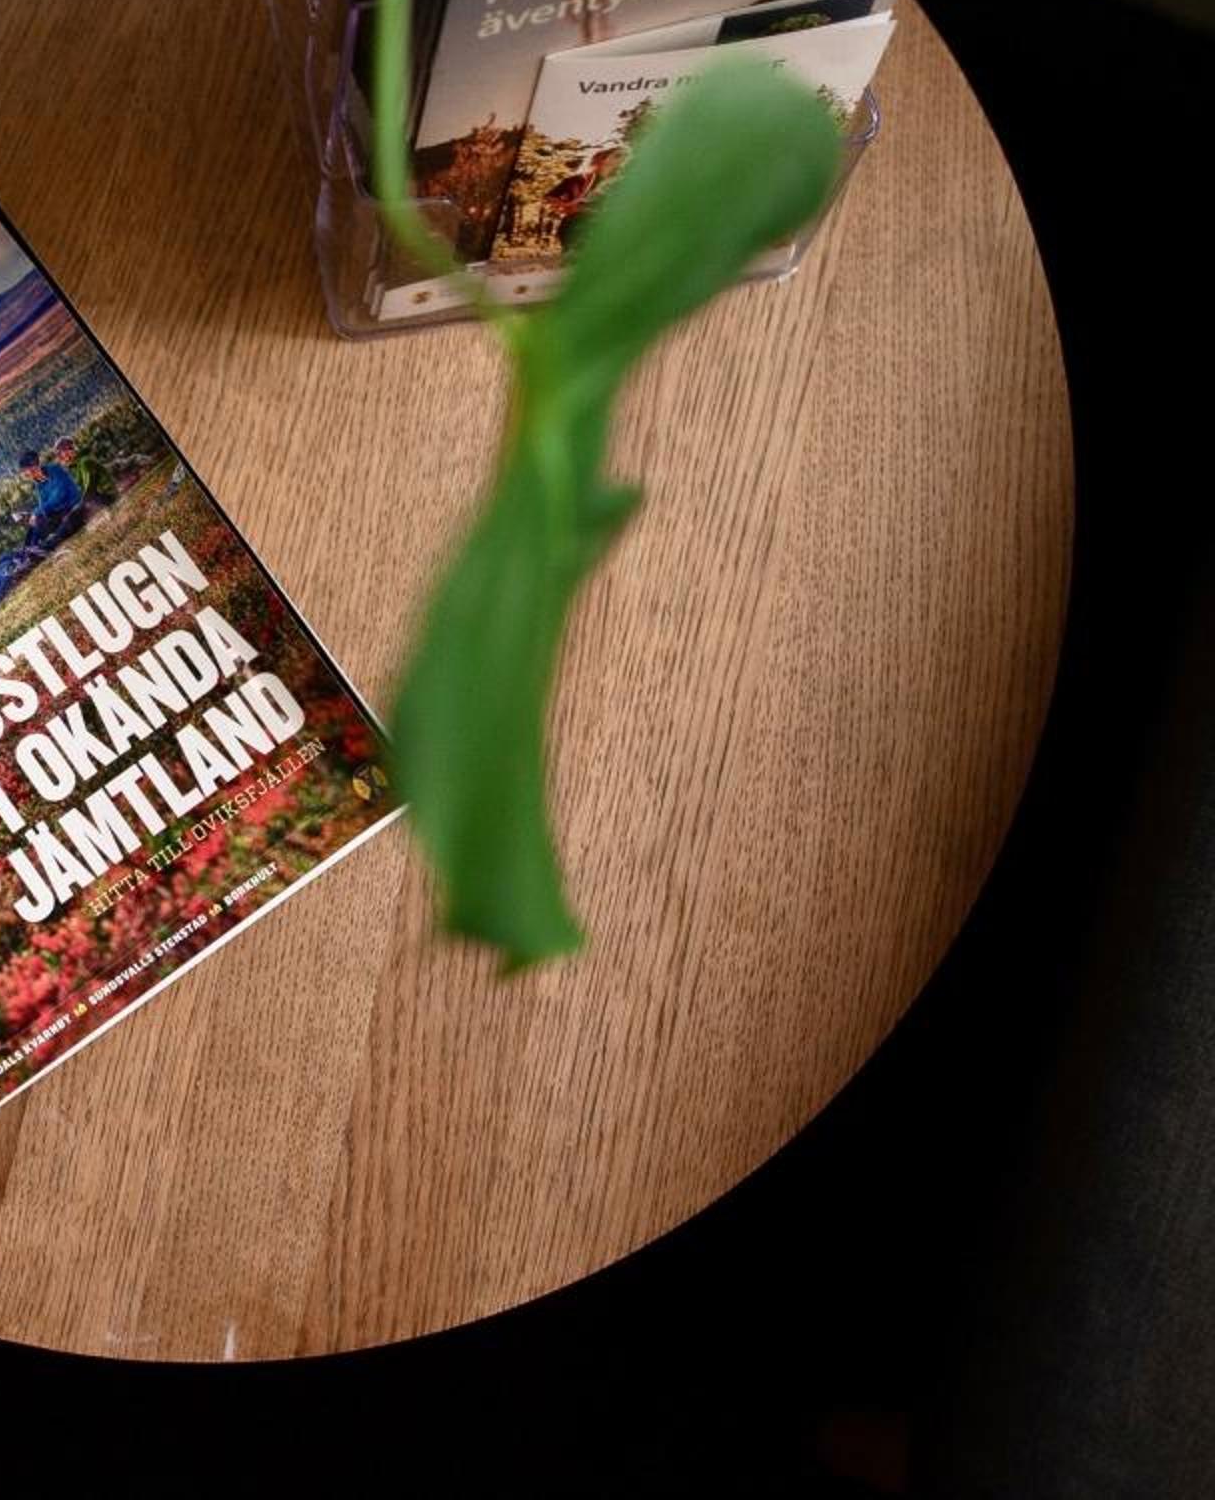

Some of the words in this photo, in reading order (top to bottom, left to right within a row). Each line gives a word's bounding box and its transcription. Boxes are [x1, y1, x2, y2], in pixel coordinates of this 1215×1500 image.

[578, 77, 669, 95] Vandra
[6, 672, 304, 920] JÄMTLAND
[16, 604, 259, 800] OKÄNDA
[21, 1014, 73, 1054] KVARNBY
[87, 952, 157, 1005] SUNDSVALLS
[152, 913, 209, 957] STENSTAD
[222, 861, 279, 905] BORKHULT
[89, 868, 147, 916] HITTA
[145, 833, 193, 873] TILL
